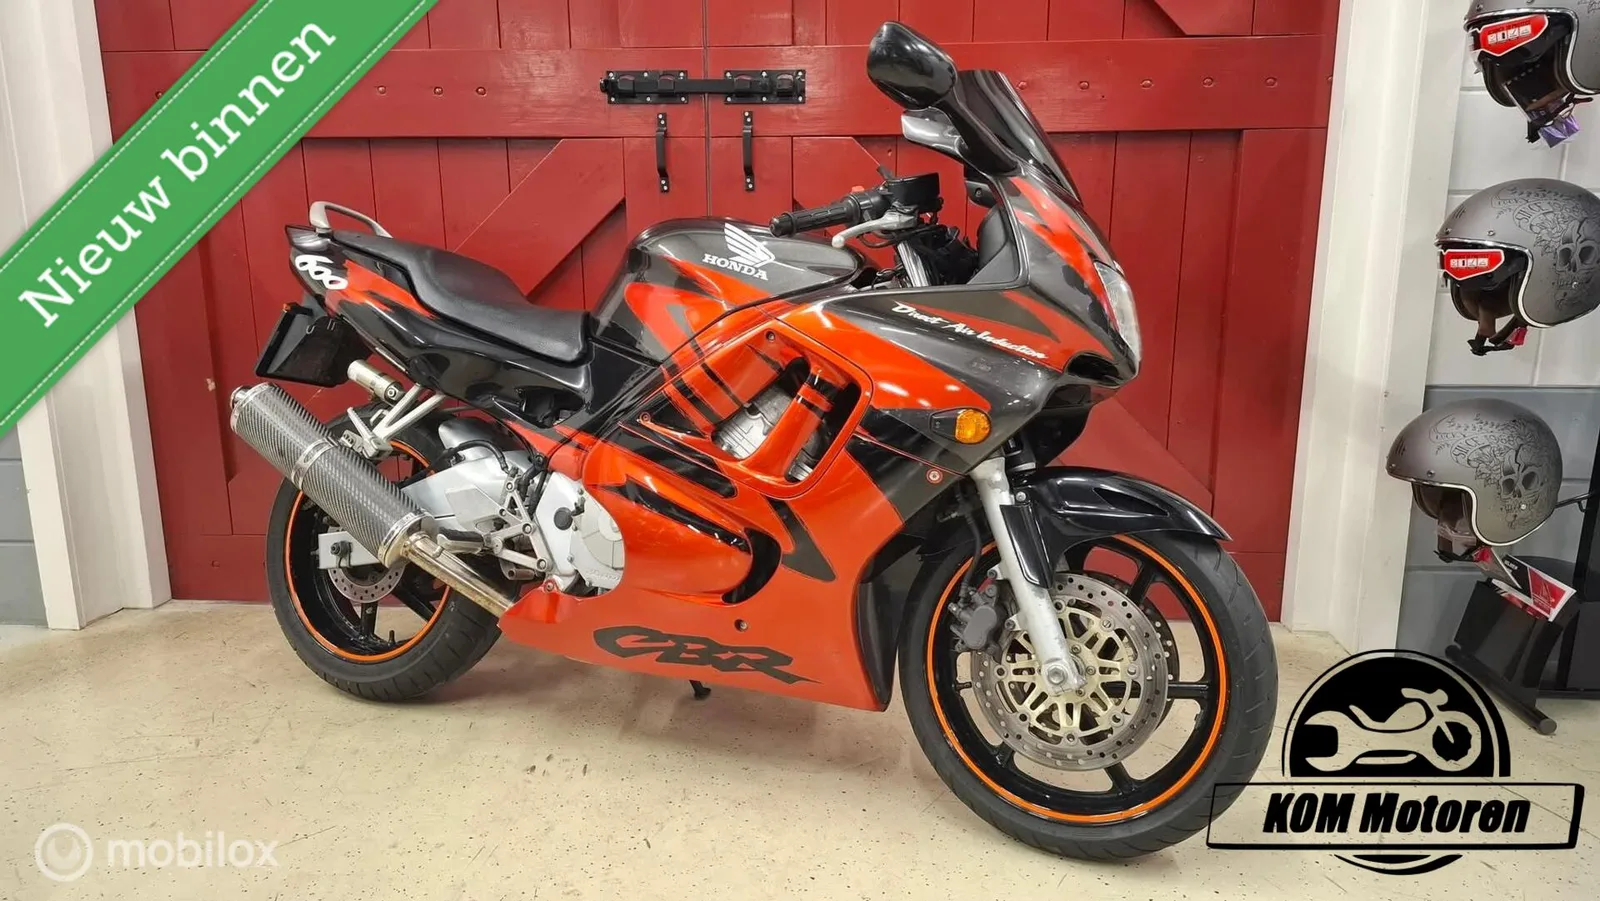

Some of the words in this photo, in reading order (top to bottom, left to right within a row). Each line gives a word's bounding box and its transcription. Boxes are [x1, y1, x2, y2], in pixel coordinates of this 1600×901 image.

[295, 254, 348, 290] 600
[702, 253, 768, 281] HONDA
[892, 300, 949, 325] Direct
[942, 322, 976, 336] Air
[977, 330, 1048, 359] Induction
[1453, 436, 1485, 458] SINCE
[593, 625, 823, 684] CBR
